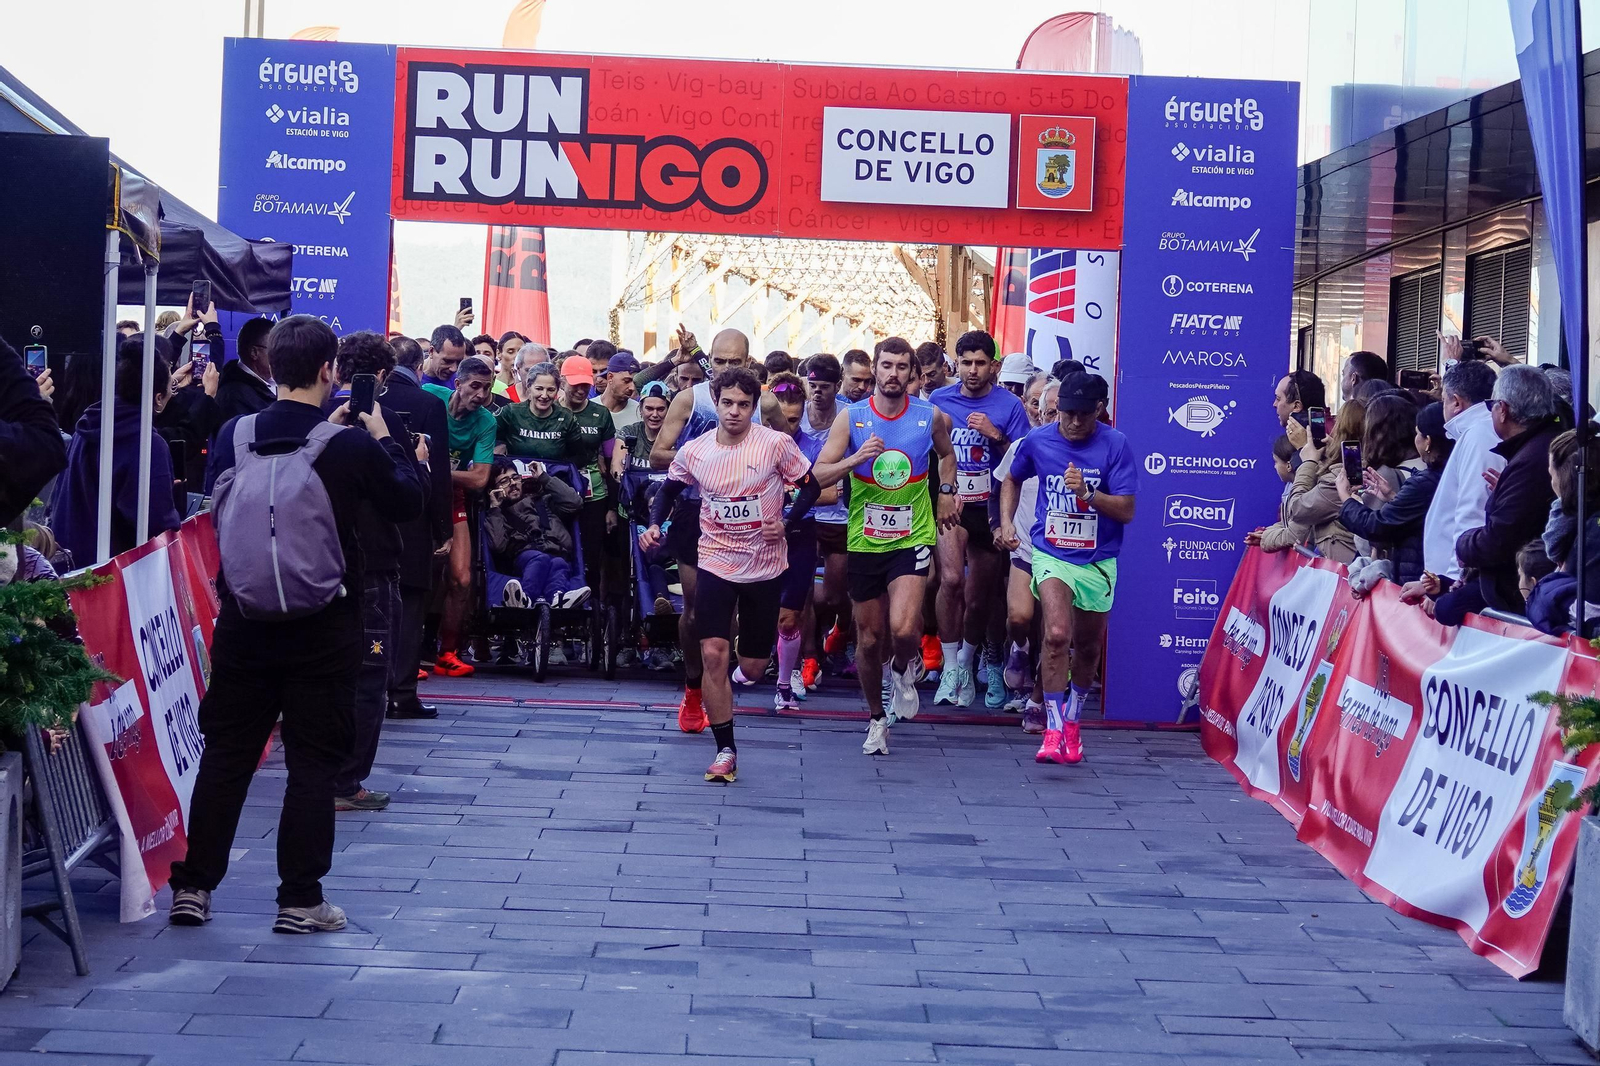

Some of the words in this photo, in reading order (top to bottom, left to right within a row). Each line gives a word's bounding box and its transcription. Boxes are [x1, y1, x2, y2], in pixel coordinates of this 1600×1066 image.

[259, 83, 344, 93] asociación
[598, 68, 645, 91] Teis
[667, 71, 764, 101] Vig-bay
[793, 77, 877, 101] Subida
[886, 81, 917, 103] Ao
[926, 83, 1007, 107] Castro
[1029, 86, 1074, 109] 5+5
[1083, 89, 1115, 110] Do
[415, 70, 583, 135] RUN
[287, 106, 350, 126] vialia
[659, 103, 713, 130] Vigo
[286, 127, 318, 138] ESTACIÓN
[320, 129, 330, 137] DE
[332, 130, 349, 139] VIGO
[1165, 122, 1249, 131] asociación
[836, 128, 995, 156] CONCELLO
[1192, 144, 1255, 163] vialia
[265, 150, 347, 174] Alcampo
[855, 159, 892, 182] DE
[903, 160, 975, 184] VIGO
[1191, 165, 1223, 175] ESTACIÓN
[1226, 167, 1235, 175] DE
[1237, 168, 1255, 176] VIGO
[255, 193, 280, 201] GRUPO
[1171, 188, 1252, 211] Alcampo
[253, 200, 329, 215] BOTAMAVI
[788, 207, 875, 230] Cáncer
[898, 211, 950, 238] Vigo
[1019, 216, 1046, 238] La
[1055, 218, 1080, 239] 21
[1161, 231, 1186, 239] GRUPO
[1159, 239, 1233, 252] BOTAMAVI
[1186, 281, 1254, 294] COTERENA
[1170, 313, 1224, 329] FIATC
[1169, 328, 1240, 337] SEGUROS
[1162, 350, 1247, 367] MAROSA
[519, 427, 562, 440] MARINES
[1169, 456, 1257, 469] TECHNOLOGY
[967, 479, 975, 490] 6
[723, 504, 750, 519] 206
[881, 513, 896, 526] 96
[723, 523, 752, 531] Alcampo
[873, 529, 901, 538] Alcampo
[1063, 521, 1082, 535] 171
[1055, 538, 1085, 548] Alcampo
[1179, 540, 1235, 551] FUNDACIÓN
[1178, 550, 1209, 560] CELTA
[1173, 588, 1219, 605] Feito
[1423, 675, 1536, 777] CONCELLO
[1397, 767, 1449, 838] DE
[1435, 780, 1494, 860] VIGO
